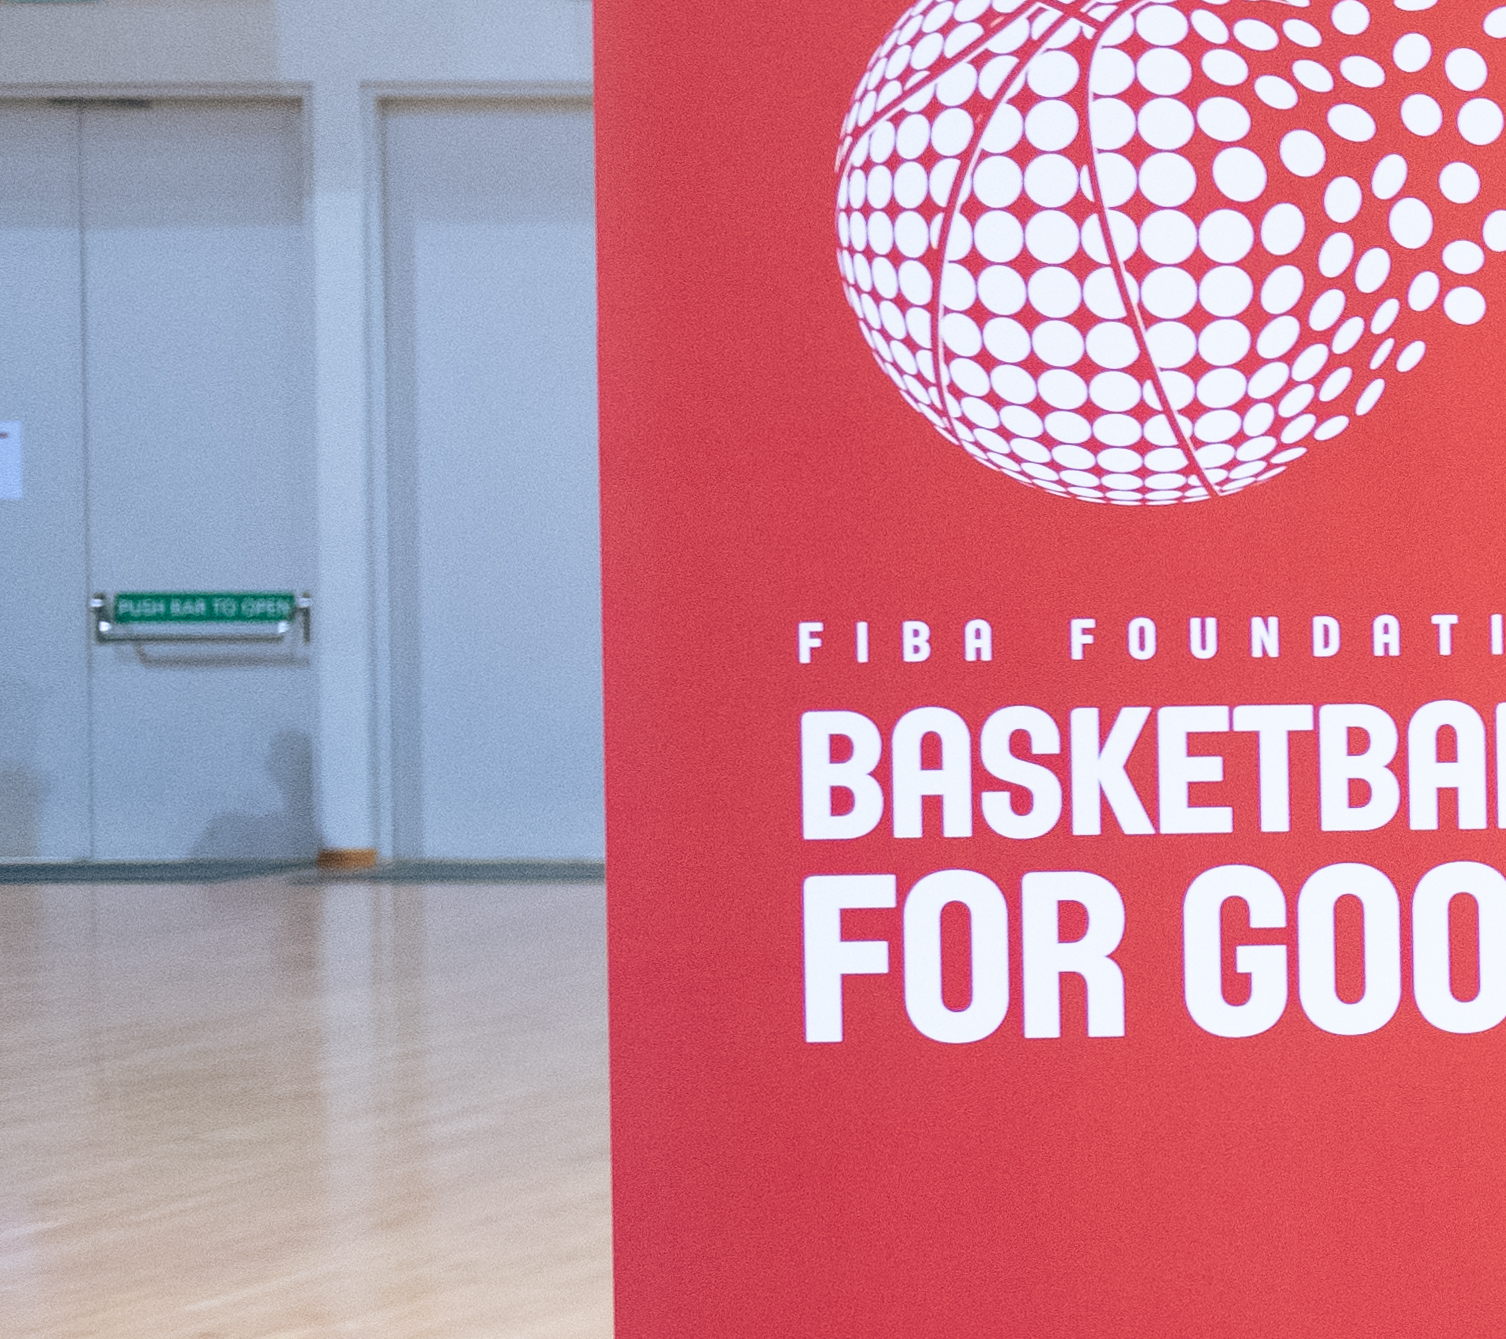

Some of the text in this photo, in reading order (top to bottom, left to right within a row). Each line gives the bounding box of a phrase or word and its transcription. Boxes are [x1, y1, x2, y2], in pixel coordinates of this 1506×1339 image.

[118, 597, 291, 617] PUSH BAR TO OPEN
[798, 619, 995, 663] FIBA
[802, 868, 1126, 1045] FOR
